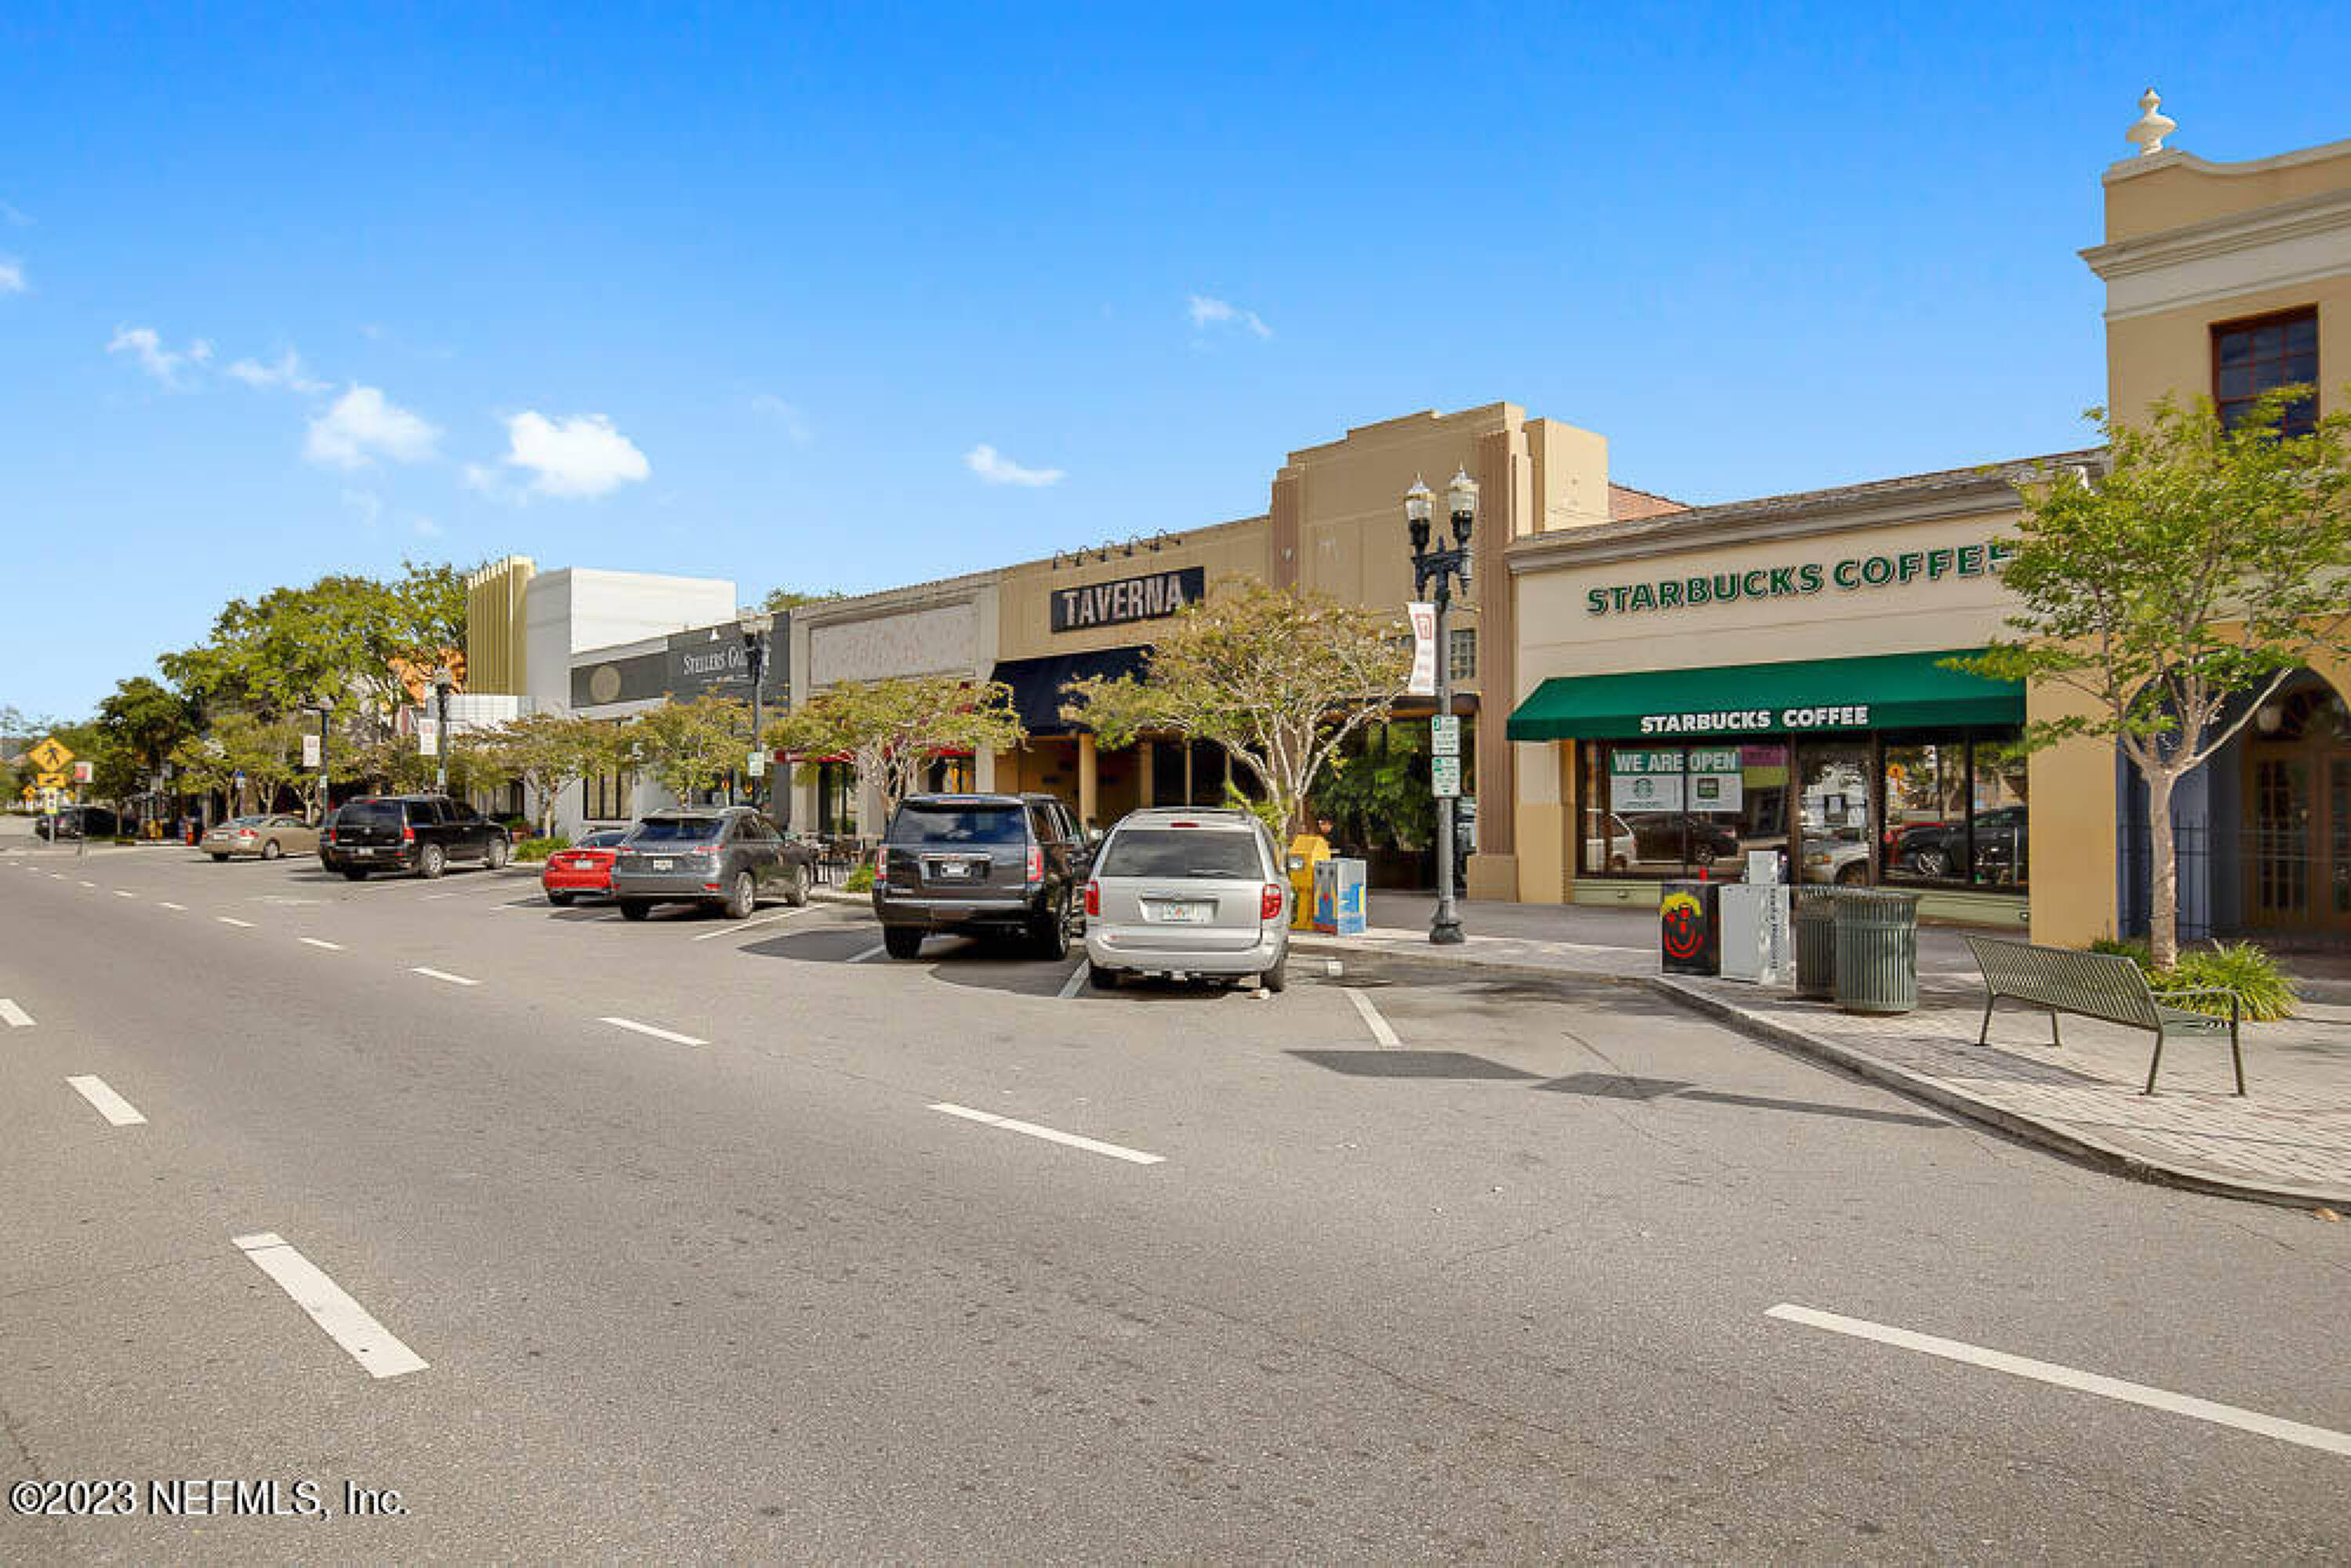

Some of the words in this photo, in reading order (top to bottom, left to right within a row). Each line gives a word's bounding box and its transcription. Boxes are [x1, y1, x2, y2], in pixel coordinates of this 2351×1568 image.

[1062, 574, 1185, 626] TAVERNA
[1586, 563, 1824, 615] STARBUCKS
[1640, 710, 1772, 733] STARBUCKS
[1782, 706, 1869, 728] COFFEE
[1614, 753, 1645, 772] WE
[1647, 753, 1684, 772] ARE
[1689, 750, 1736, 772] OPEN
